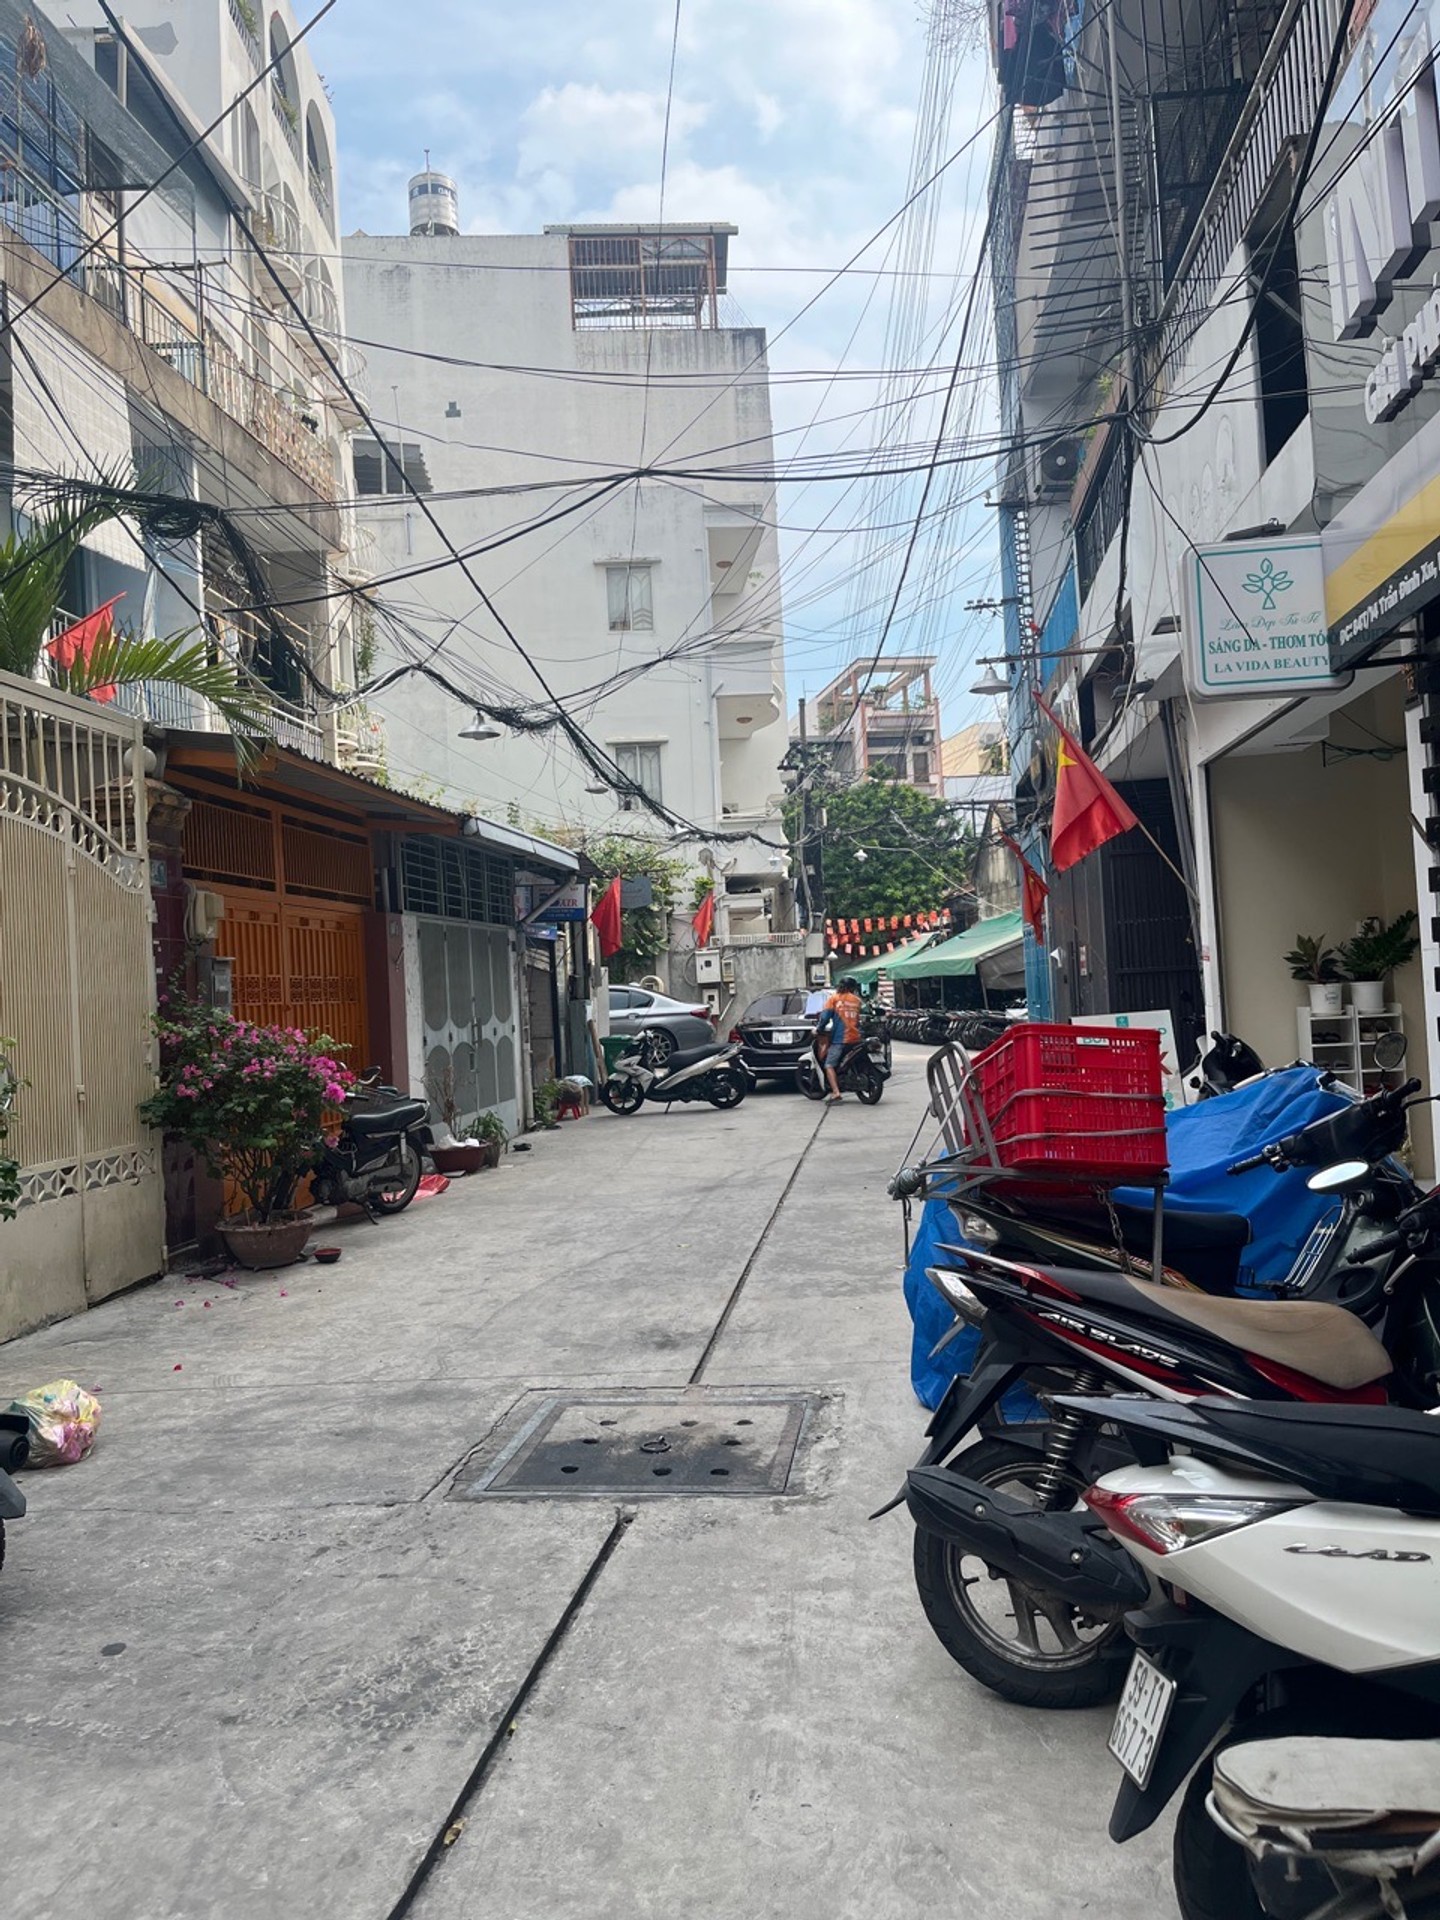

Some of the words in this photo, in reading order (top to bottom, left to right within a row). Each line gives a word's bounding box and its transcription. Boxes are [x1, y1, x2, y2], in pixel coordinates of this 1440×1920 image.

[1208, 636, 1240, 655] SÁNG
[1244, 639, 1261, 652] DA
[1269, 633, 1307, 650] THƠM
[1308, 629, 1328, 647] TÓ
[1214, 662, 1233, 673] LA
[1235, 660, 1270, 672] VIDA
[1274, 655, 1329, 669] BEAUTY
[1038, 1312, 1086, 1335] AIR
[1088, 1327, 1180, 1368] BLADE
[1128, 1660, 1166, 1726] 59-T1
